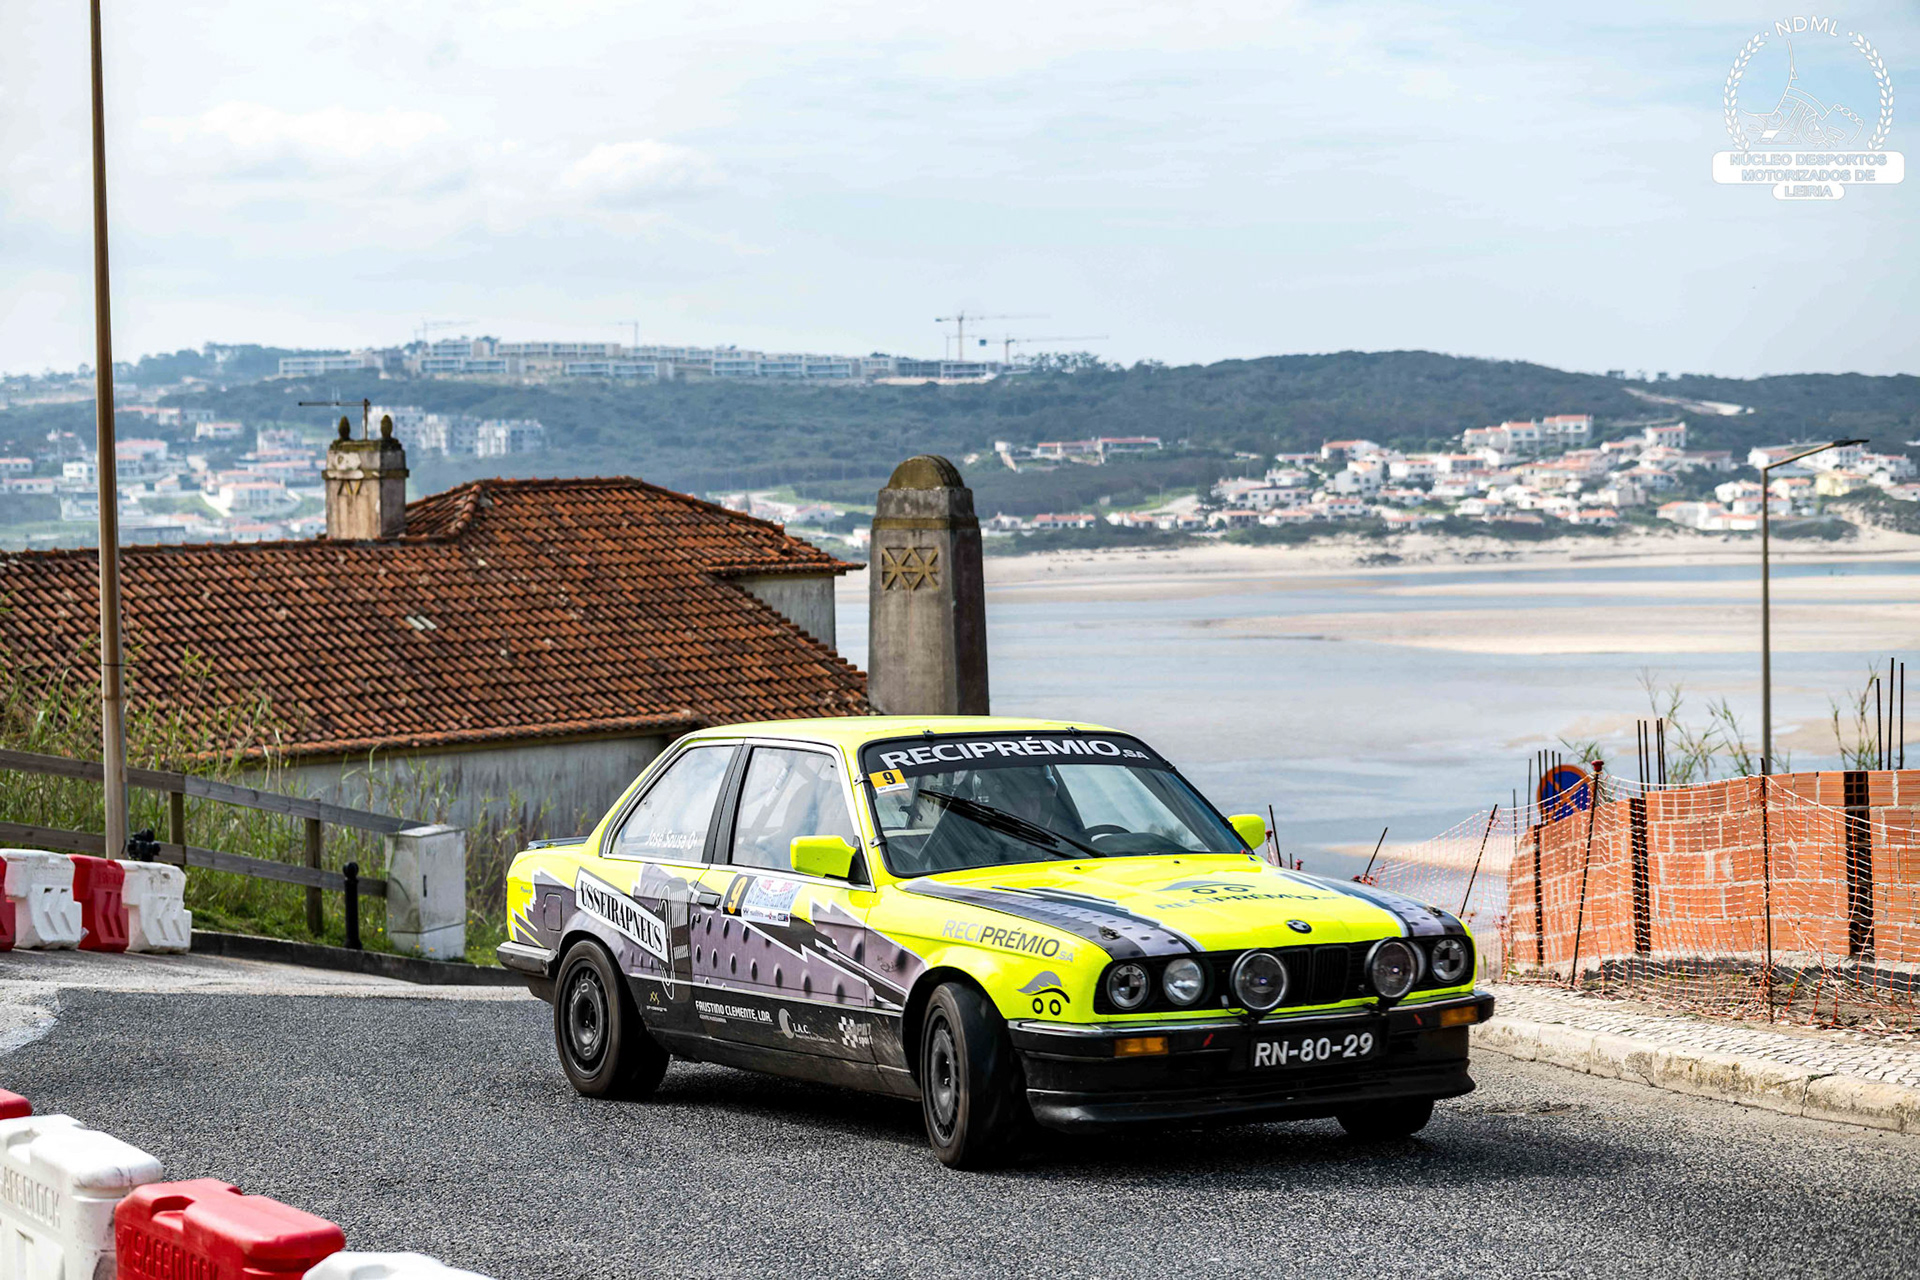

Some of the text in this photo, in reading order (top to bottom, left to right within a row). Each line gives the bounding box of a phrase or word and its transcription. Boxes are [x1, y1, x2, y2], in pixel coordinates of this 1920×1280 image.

[882, 771, 896, 785] 9
[727, 876, 748, 914] 9
[580, 879, 662, 953] USSEIRAPNEUS
[695, 1000, 724, 1015] FAUSTINO
[724, 1004, 758, 1021] CLEMENTE,
[1254, 1032, 1374, 1067] RN-80-29
